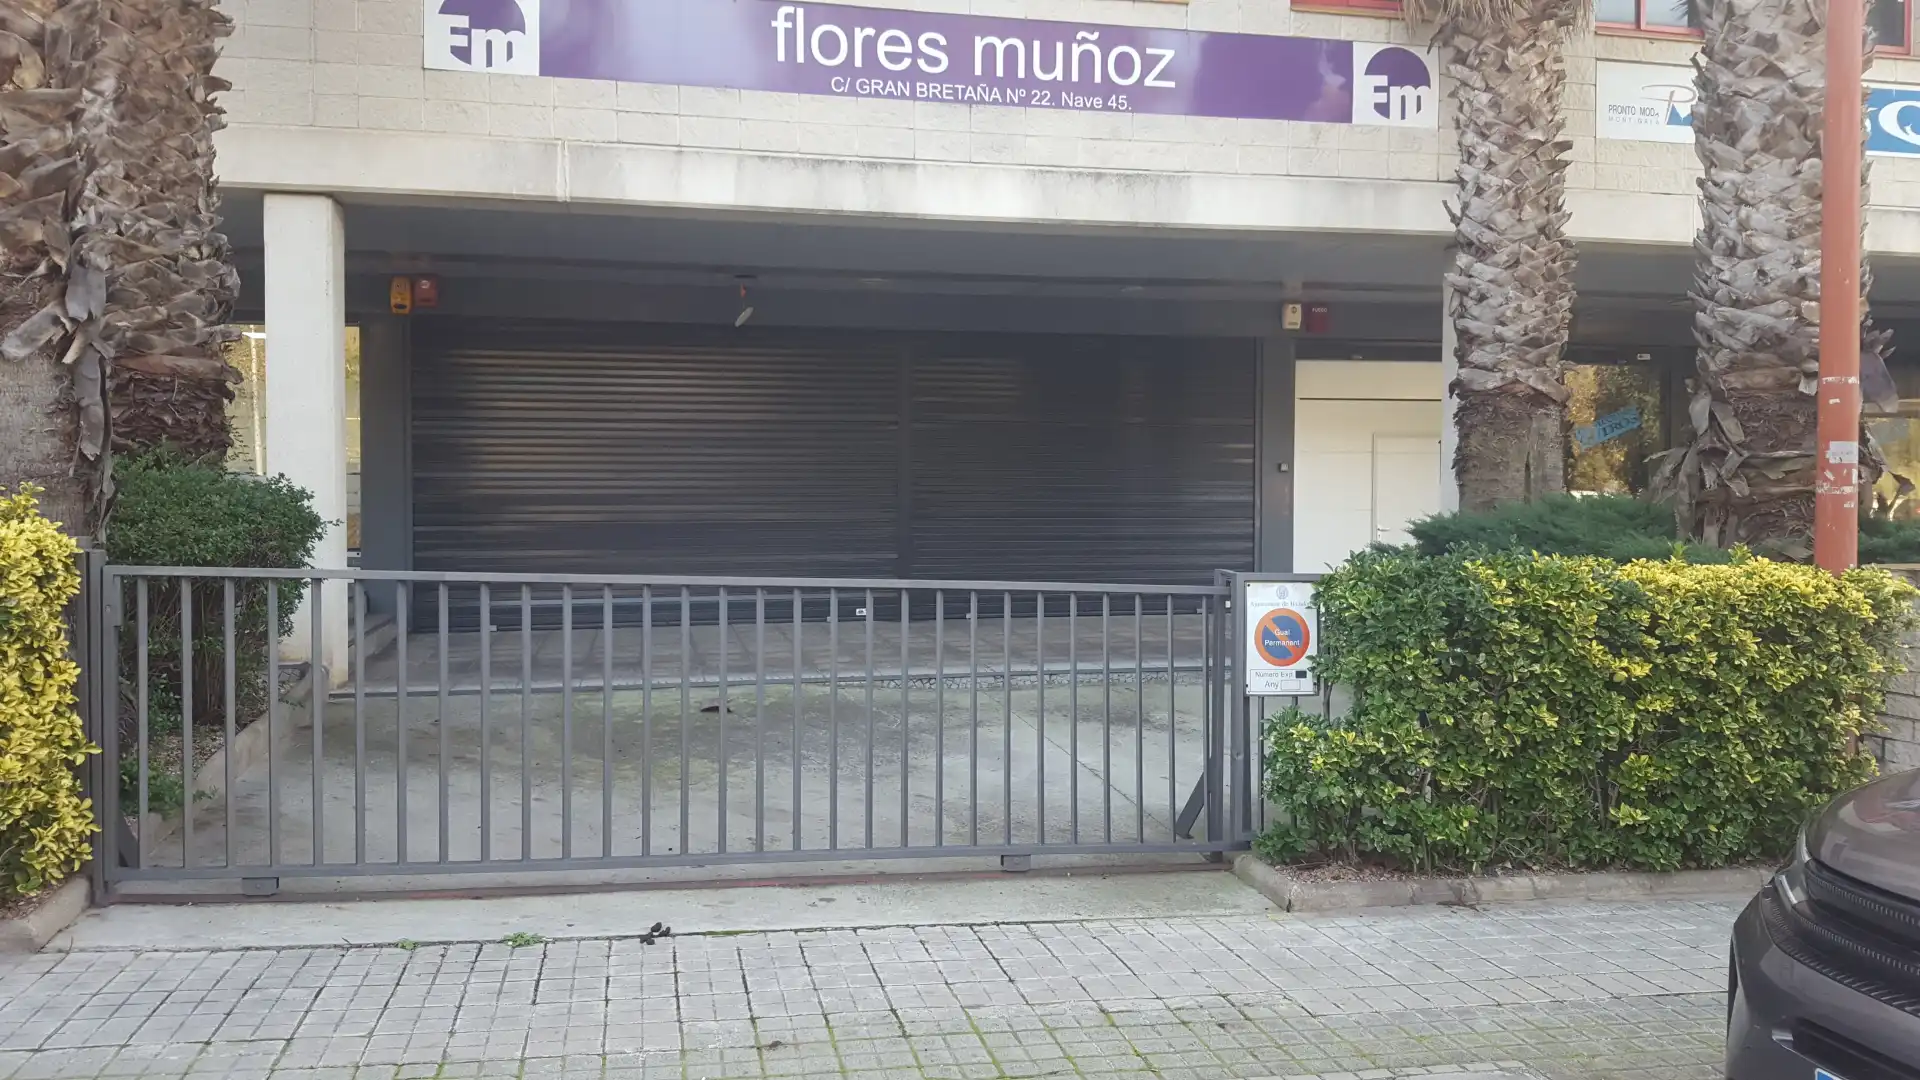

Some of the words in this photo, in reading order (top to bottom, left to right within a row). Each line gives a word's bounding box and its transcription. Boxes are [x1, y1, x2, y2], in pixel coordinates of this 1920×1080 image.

[771, 6, 949, 74] flores
[973, 30, 1177, 88] muñoz
[831, 76, 851, 92] C/
[855, 78, 910, 97] GRAN
[916, 82, 1002, 103] BRETAÑA
[1031, 90, 1056, 106] 22.
[1061, 91, 1103, 109] Nave
[1107, 94, 1132, 111] 45.
[1608, 104, 1636, 116] PRONTO
[1264, 639, 1301, 647] Permanent
[1264, 681, 1279, 690] Any
